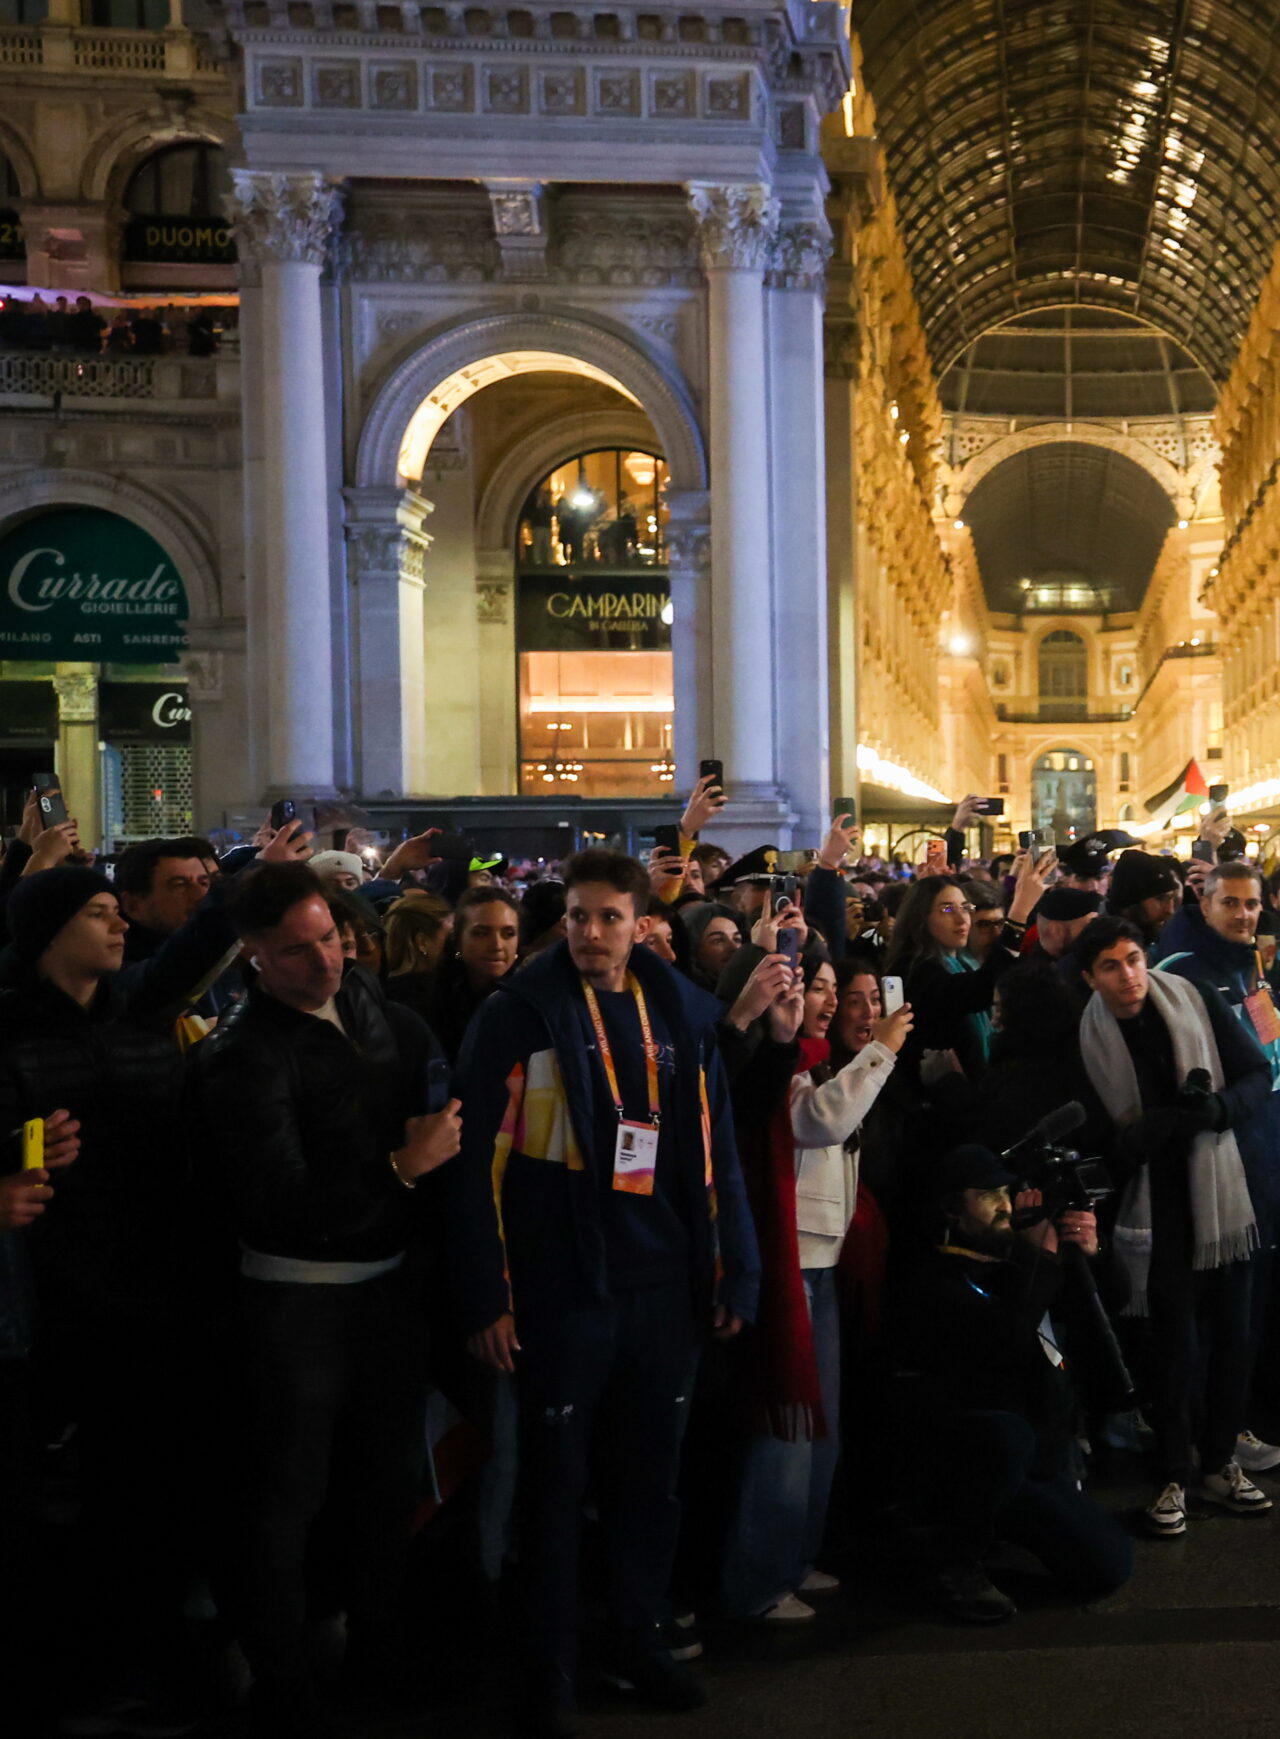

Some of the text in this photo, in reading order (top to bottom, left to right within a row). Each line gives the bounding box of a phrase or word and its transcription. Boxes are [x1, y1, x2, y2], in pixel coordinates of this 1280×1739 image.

[146, 228, 229, 247] DUOMO
[8, 547, 179, 612] Currado
[80, 601, 178, 615] GIOIELLERIE
[546, 592, 671, 618] CAMPARIN
[73, 632, 102, 643] ASTI
[122, 633, 190, 645] SANREMO
